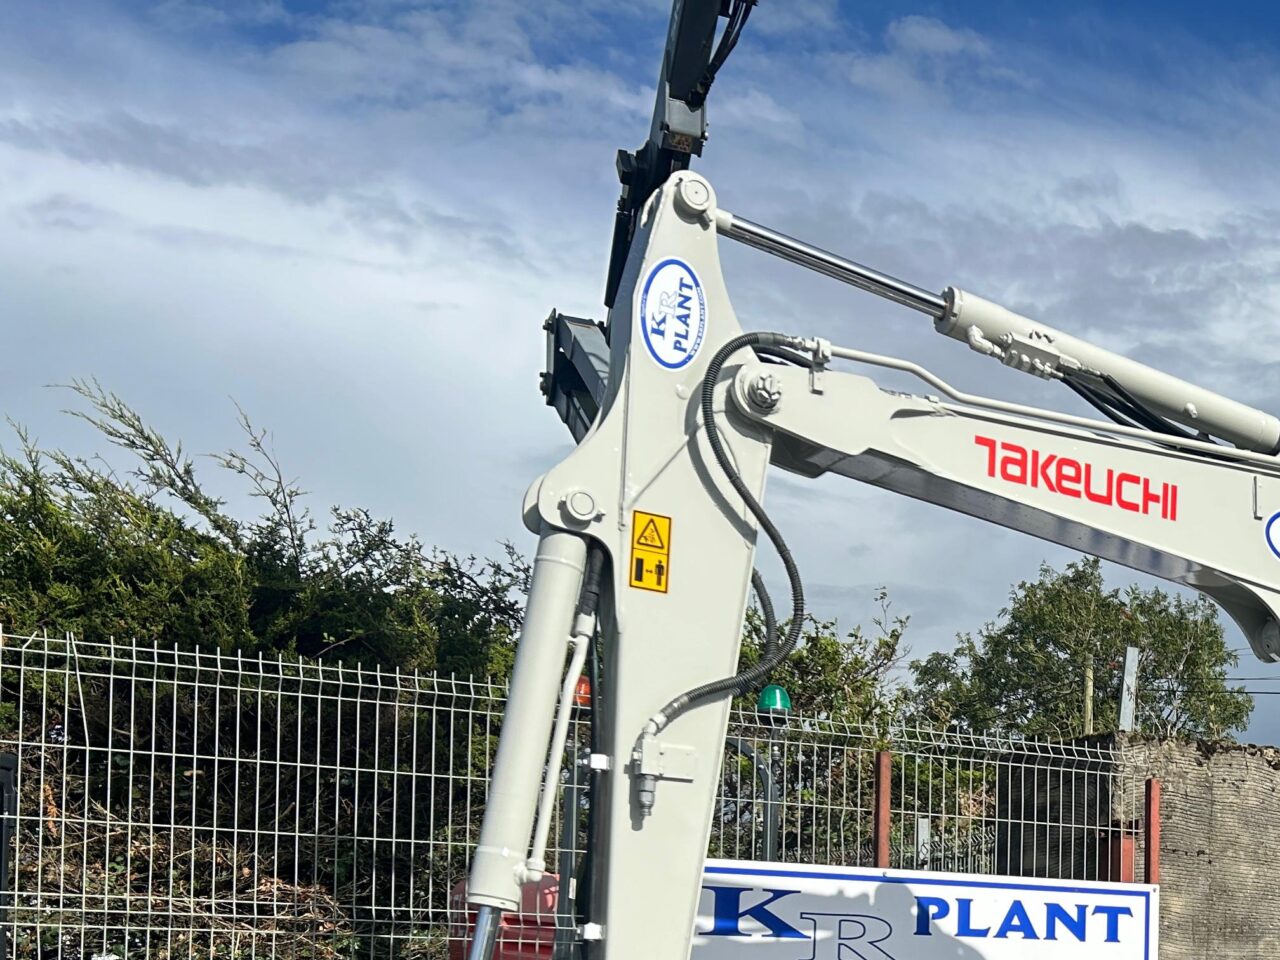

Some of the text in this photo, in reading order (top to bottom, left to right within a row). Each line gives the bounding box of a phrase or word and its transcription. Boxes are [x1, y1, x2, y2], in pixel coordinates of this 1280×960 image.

[673, 277, 693, 354] PLANT
[974, 434, 1178, 521] TAKEUCHI
[913, 896, 1134, 943] PLANT
